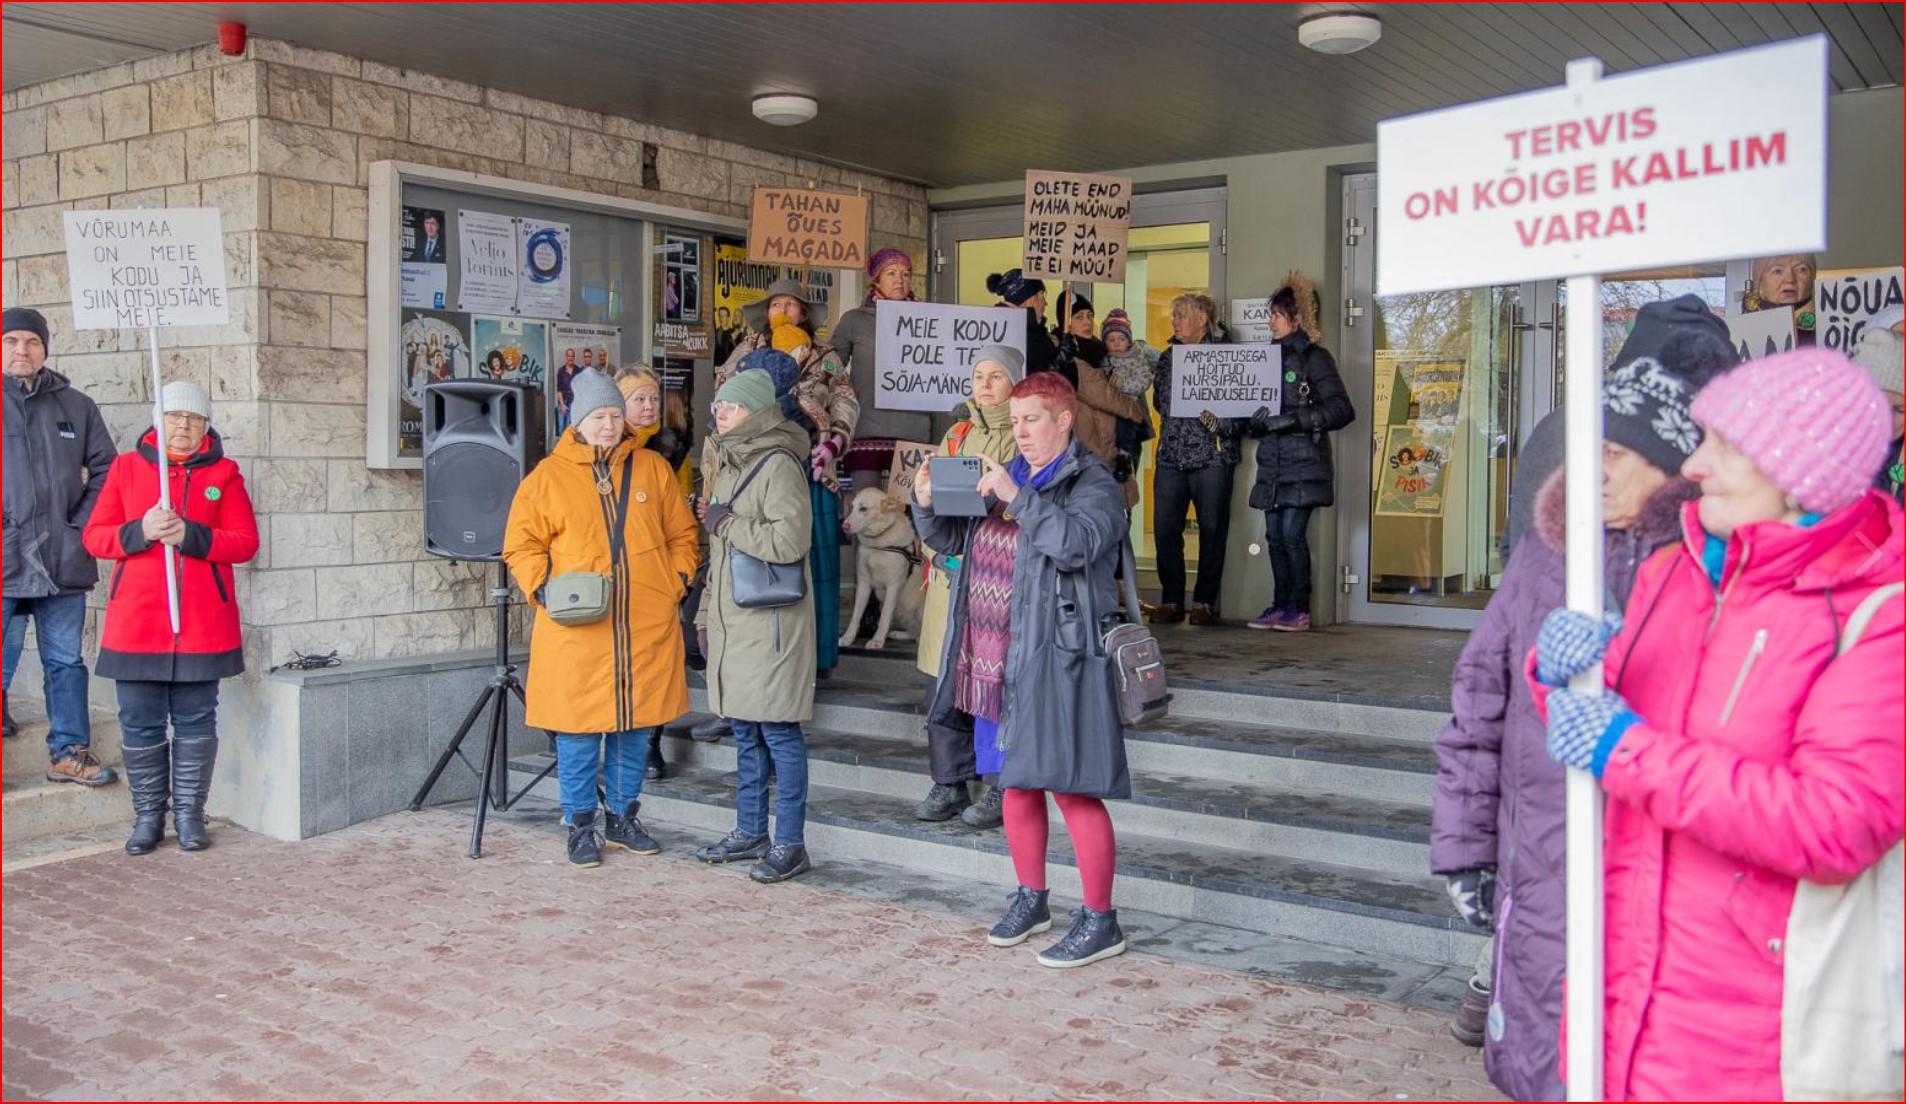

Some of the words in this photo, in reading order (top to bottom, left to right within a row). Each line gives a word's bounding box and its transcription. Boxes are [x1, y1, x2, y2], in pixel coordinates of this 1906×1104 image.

[1505, 107, 1657, 160] TERVIS
[1404, 187, 1459, 221] ON
[1473, 167, 1597, 211] KÕIGE
[1611, 132, 1787, 190] KALLIM
[1034, 181, 1080, 196] OLETE
[1088, 183, 1121, 197] END
[766, 193, 840, 214] TAHAN
[1030, 198, 1070, 216] MAHA
[1074, 199, 1130, 220] MÜÜNUD!
[76, 218, 172, 239] VÕRUMAA
[787, 212, 842, 235] ÕUES
[1029, 221, 1067, 237] MEID
[1074, 223, 1097, 239] JA
[1515, 202, 1647, 248] VARA!
[94, 246, 118, 262] ON
[151, 244, 197, 261] MEIE
[762, 236, 860, 262] MAGADA
[1029, 239, 1064, 254] MEIE
[1073, 242, 1119, 256] MAAD
[111, 266, 159, 287] KODU
[180, 265, 203, 286] JA
[1026, 256, 1043, 272] TE
[1049, 257, 1062, 273] EI
[1070, 258, 1114, 278] MÜÜ!
[83, 289, 119, 310] SIIN
[123, 287, 222, 307] OTSUSTAME
[116, 308, 172, 327] MEIE.
[654, 323, 688, 340] AABITSA
[896, 316, 939, 338] MEIE
[953, 318, 1008, 343] KODU
[901, 344, 945, 365] POLE
[1183, 350, 1267, 363] ARMASTUSEGA
[1197, 363, 1245, 375] HOITUD
[1182, 388, 1259, 401] LAIENDUSELE
[1261, 388, 1278, 401] EI!
